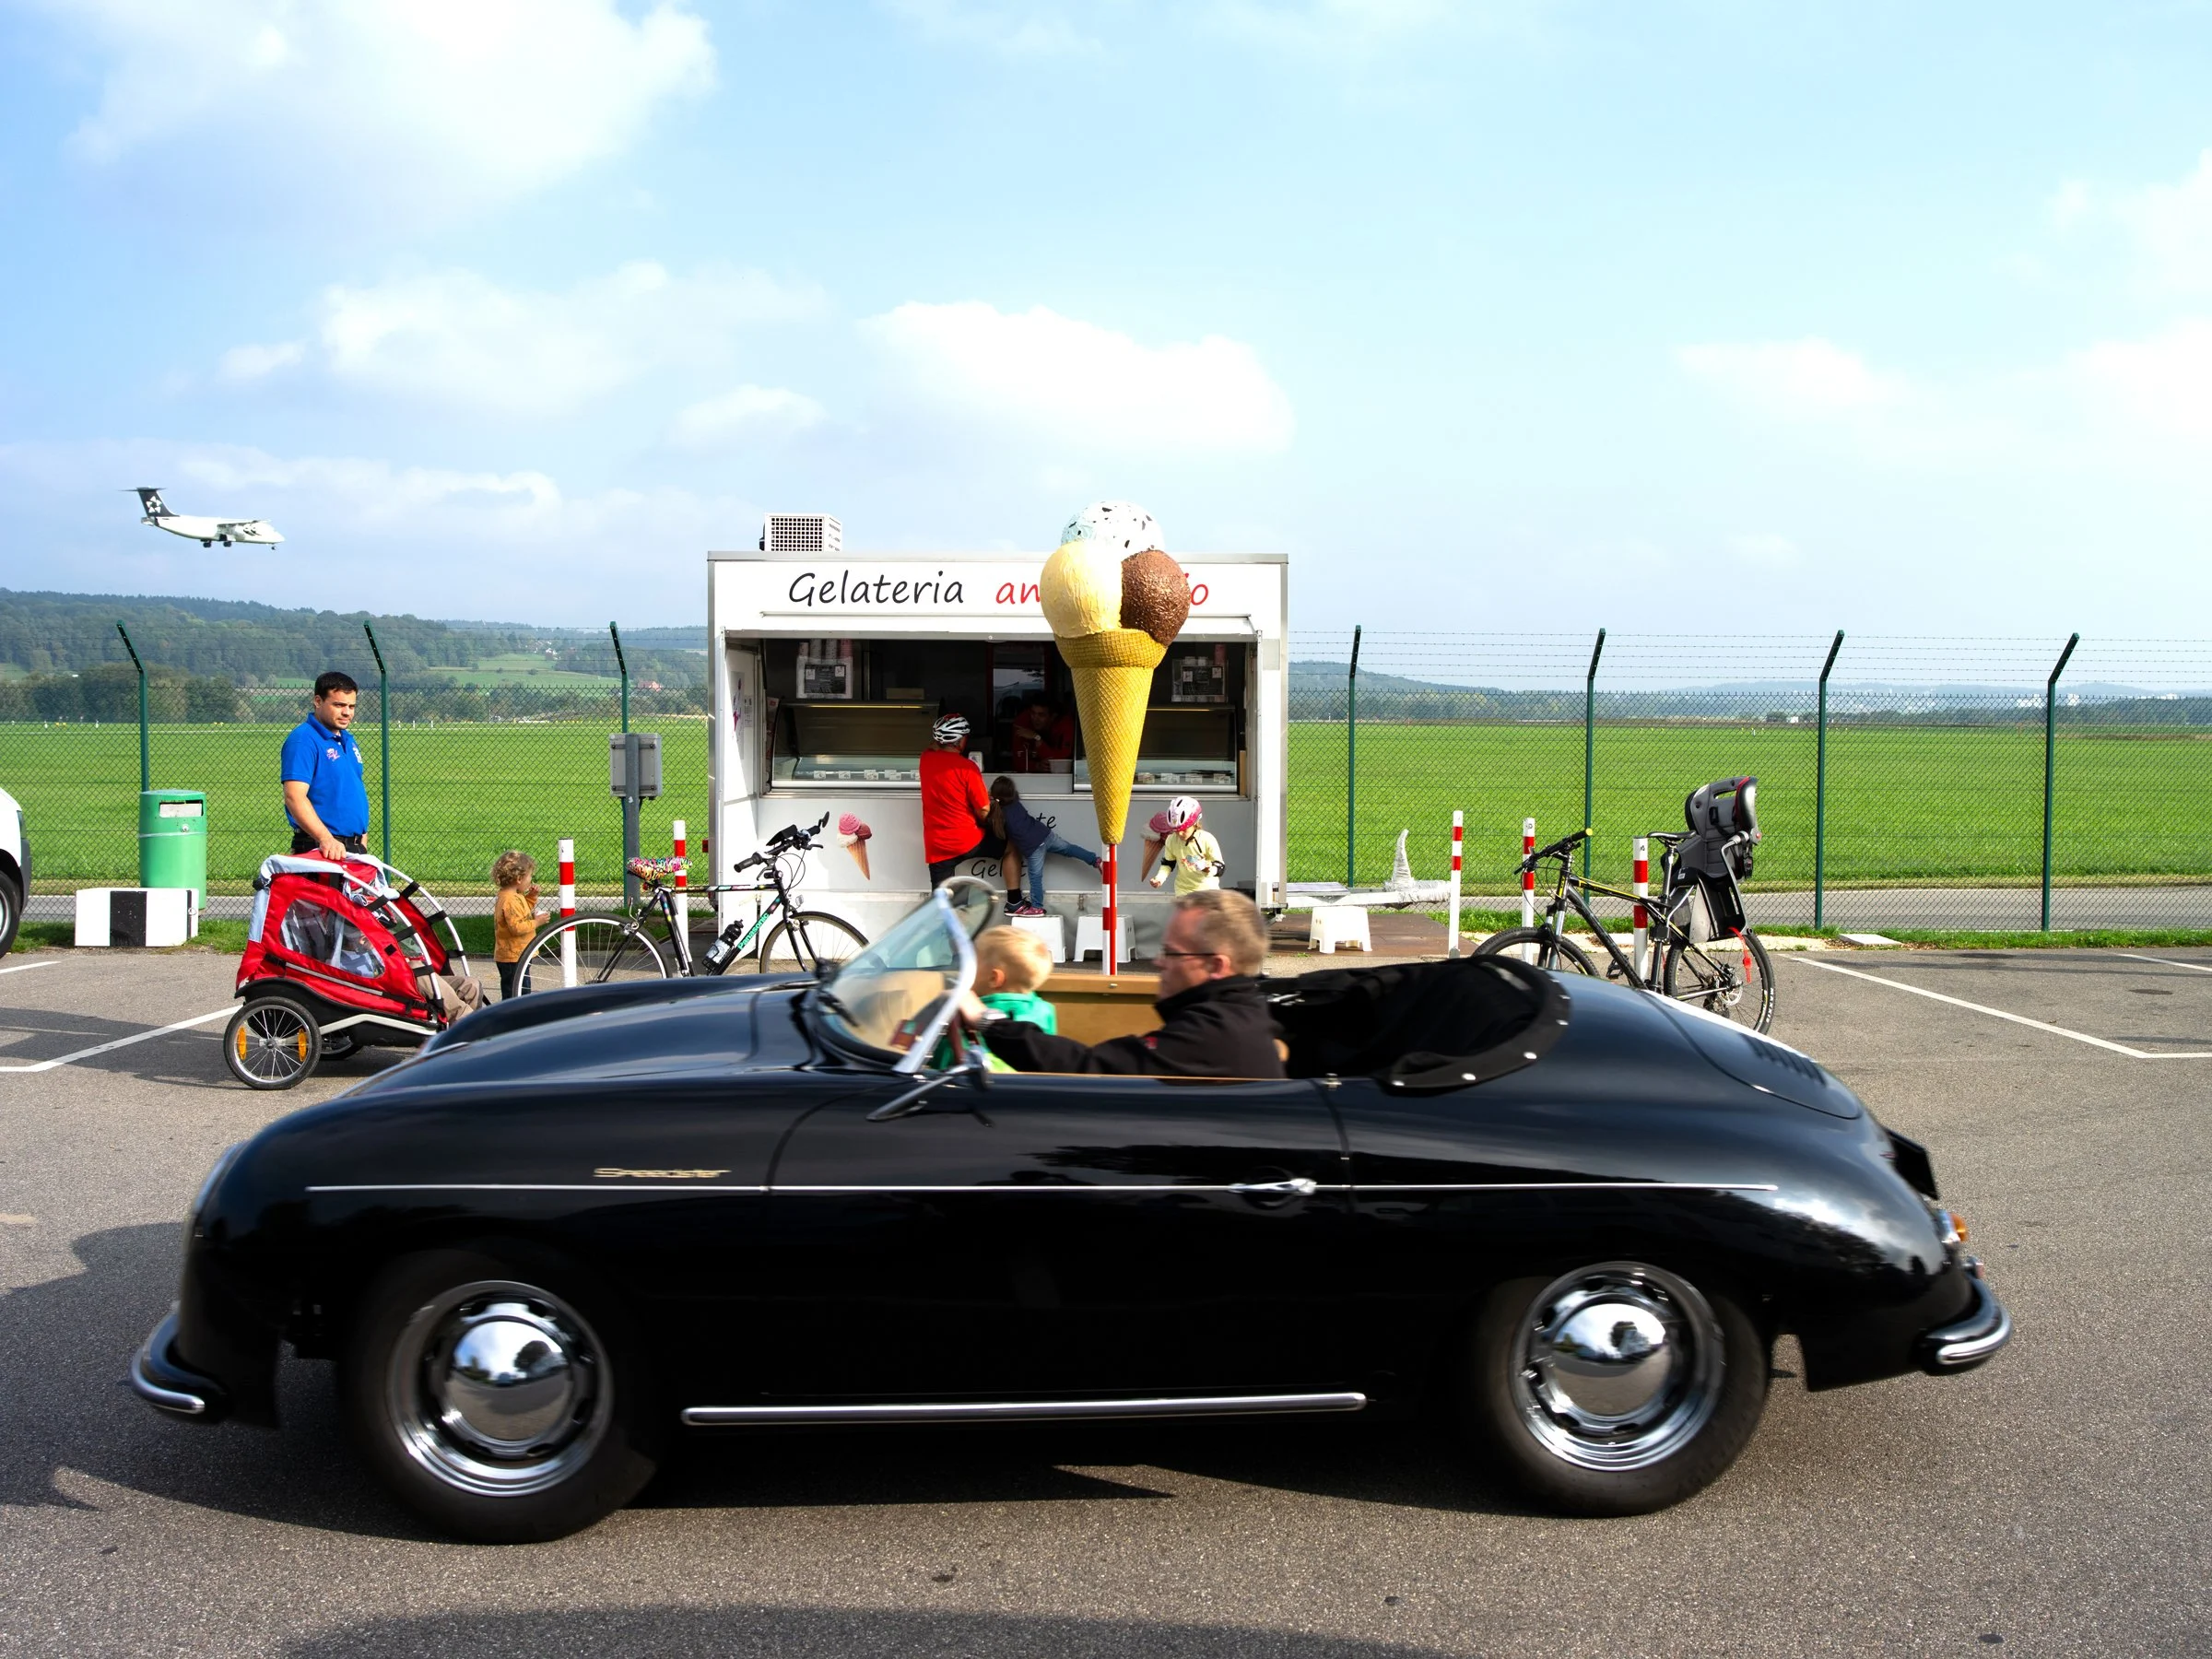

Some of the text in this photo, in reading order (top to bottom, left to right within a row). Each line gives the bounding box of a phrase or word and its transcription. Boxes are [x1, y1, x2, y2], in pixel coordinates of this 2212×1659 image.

[788, 569, 964, 607] Gelateria
[971, 859, 1029, 878] Gelt
[737, 912, 771, 950] Panasonic
